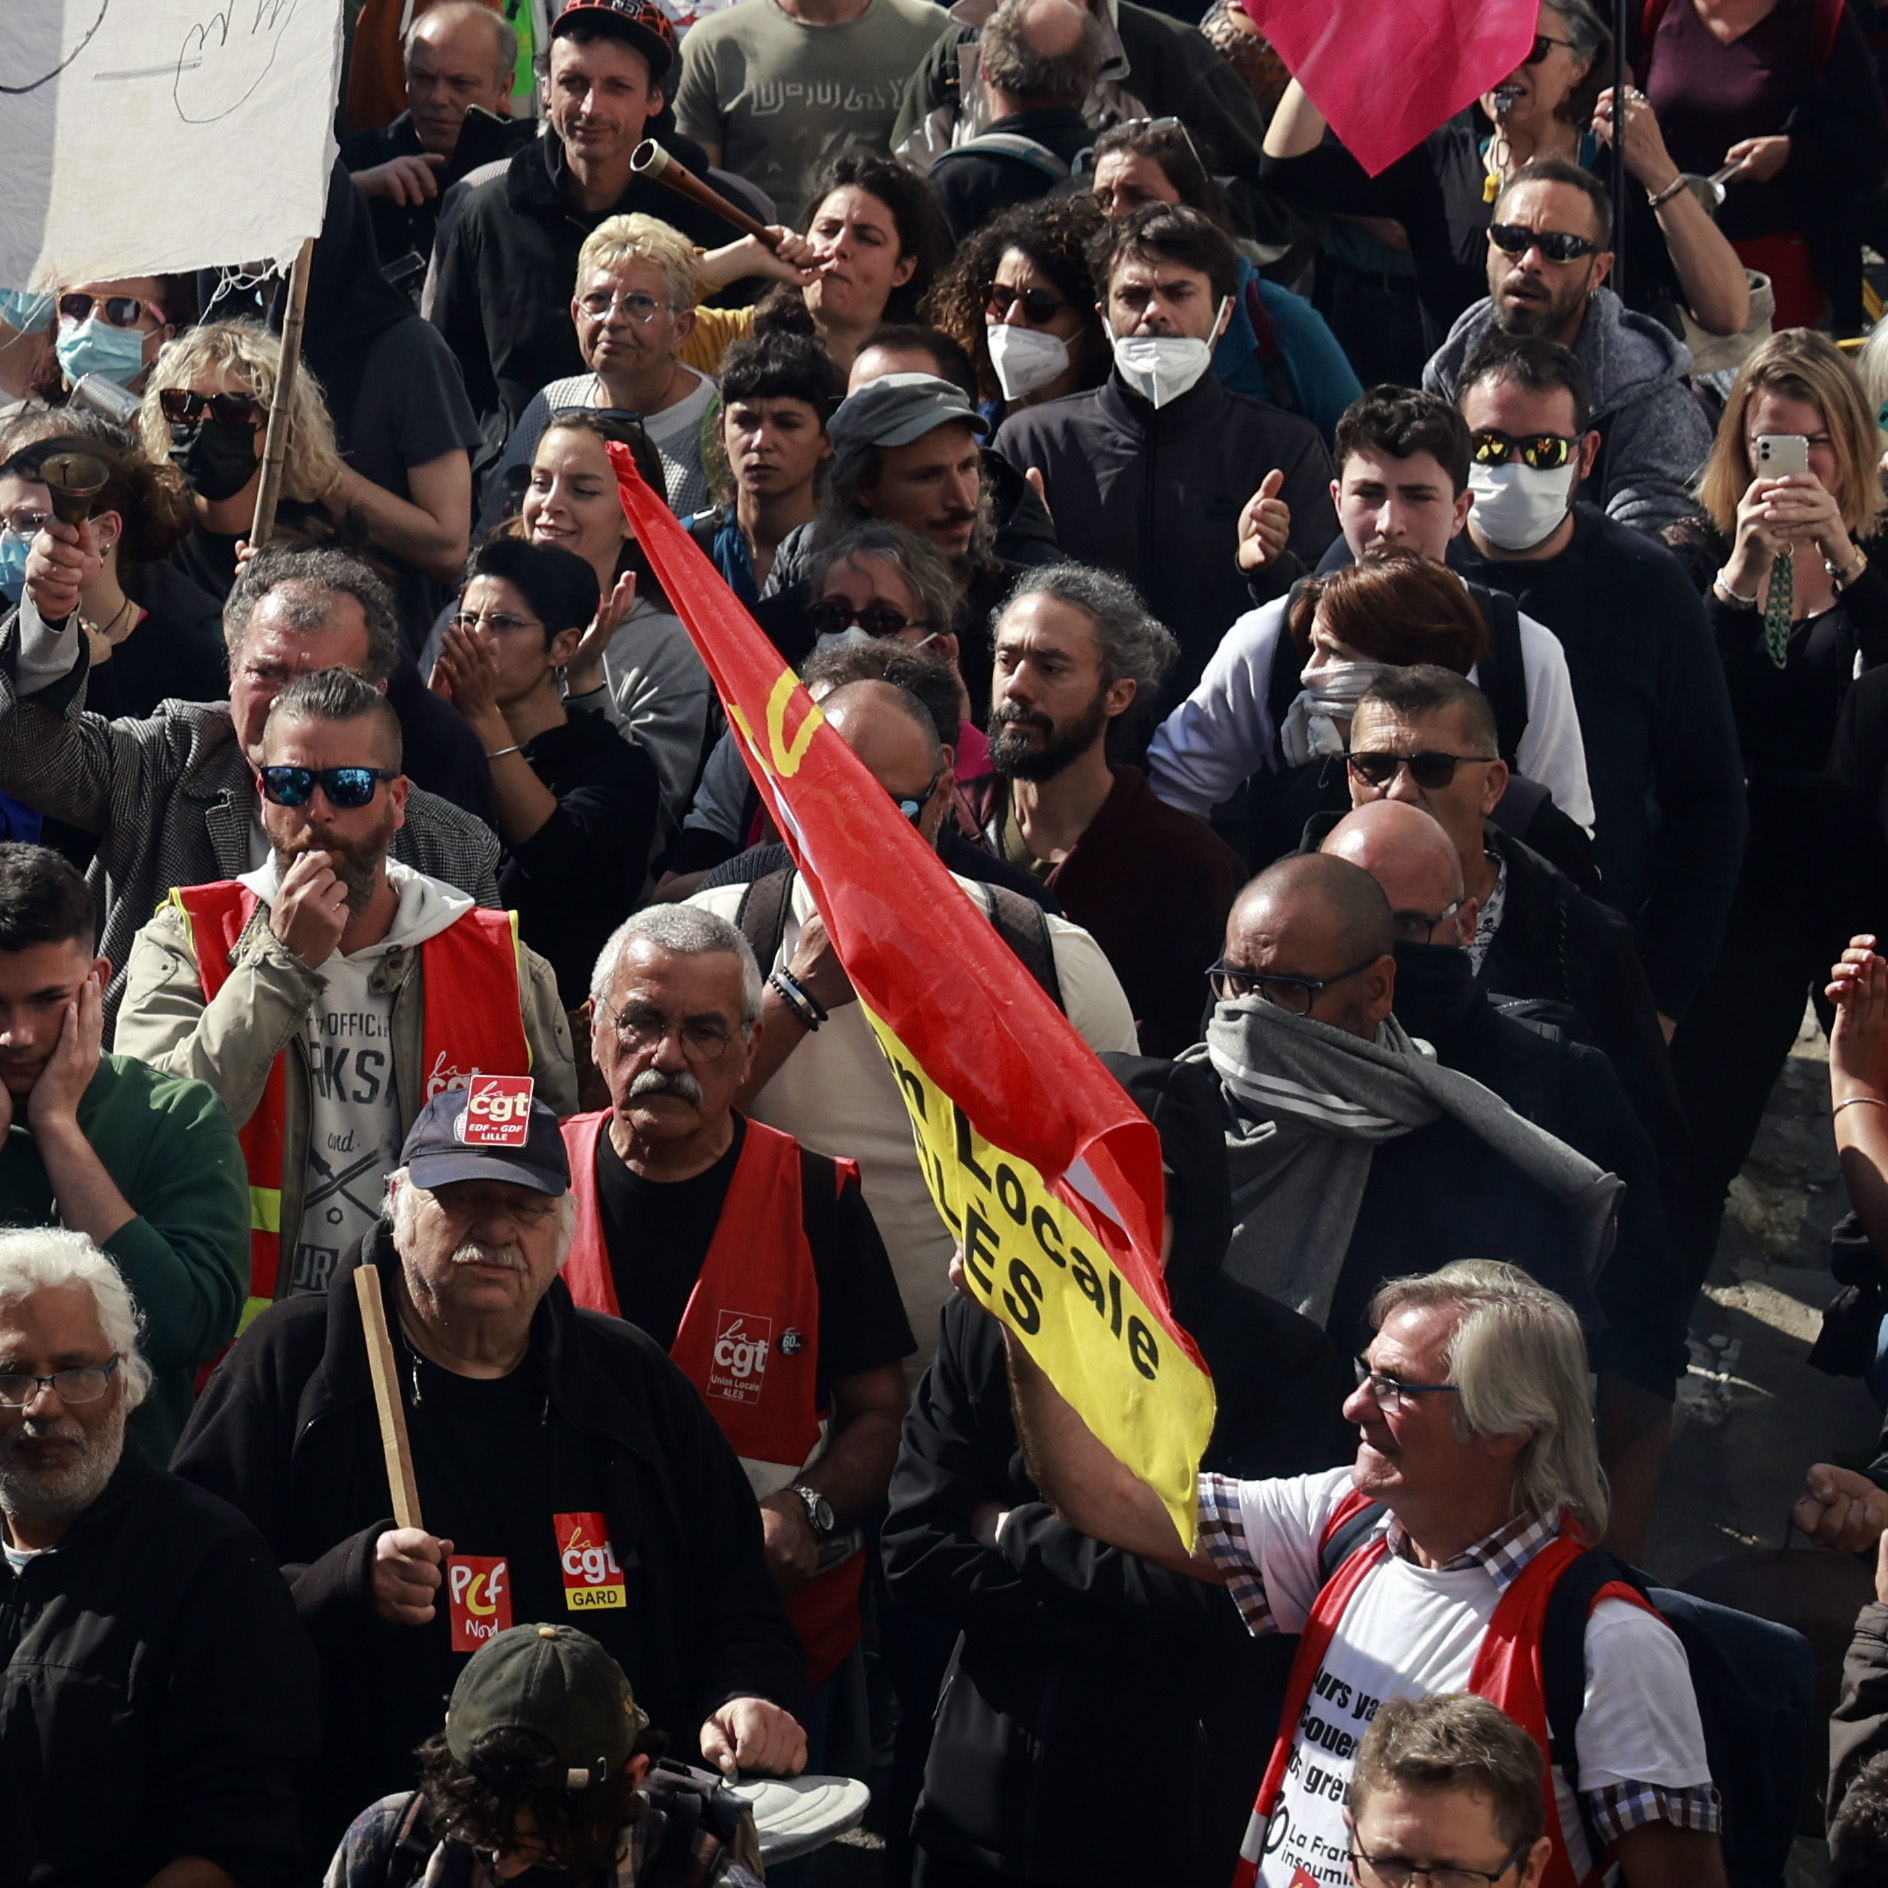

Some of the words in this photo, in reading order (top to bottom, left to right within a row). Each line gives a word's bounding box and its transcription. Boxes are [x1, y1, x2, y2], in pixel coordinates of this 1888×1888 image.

[429, 1050, 451, 1078] la
[473, 1080, 503, 1099] la
[469, 1091, 530, 1123] cgt
[469, 1123, 489, 1133] EDF
[500, 1124, 524, 1134] GDF
[480, 1131, 509, 1141] LILLE
[951, 1099, 1160, 1381] Locale
[719, 1319, 750, 1346] la
[713, 1337, 769, 1379] cgt
[710, 1374, 732, 1390] Union
[734, 1378, 762, 1394] Locale
[562, 1527, 593, 1552] la
[560, 1545, 620, 1584] cgt
[571, 1589, 619, 1606] GARD
[1288, 1823, 1307, 1848] La
